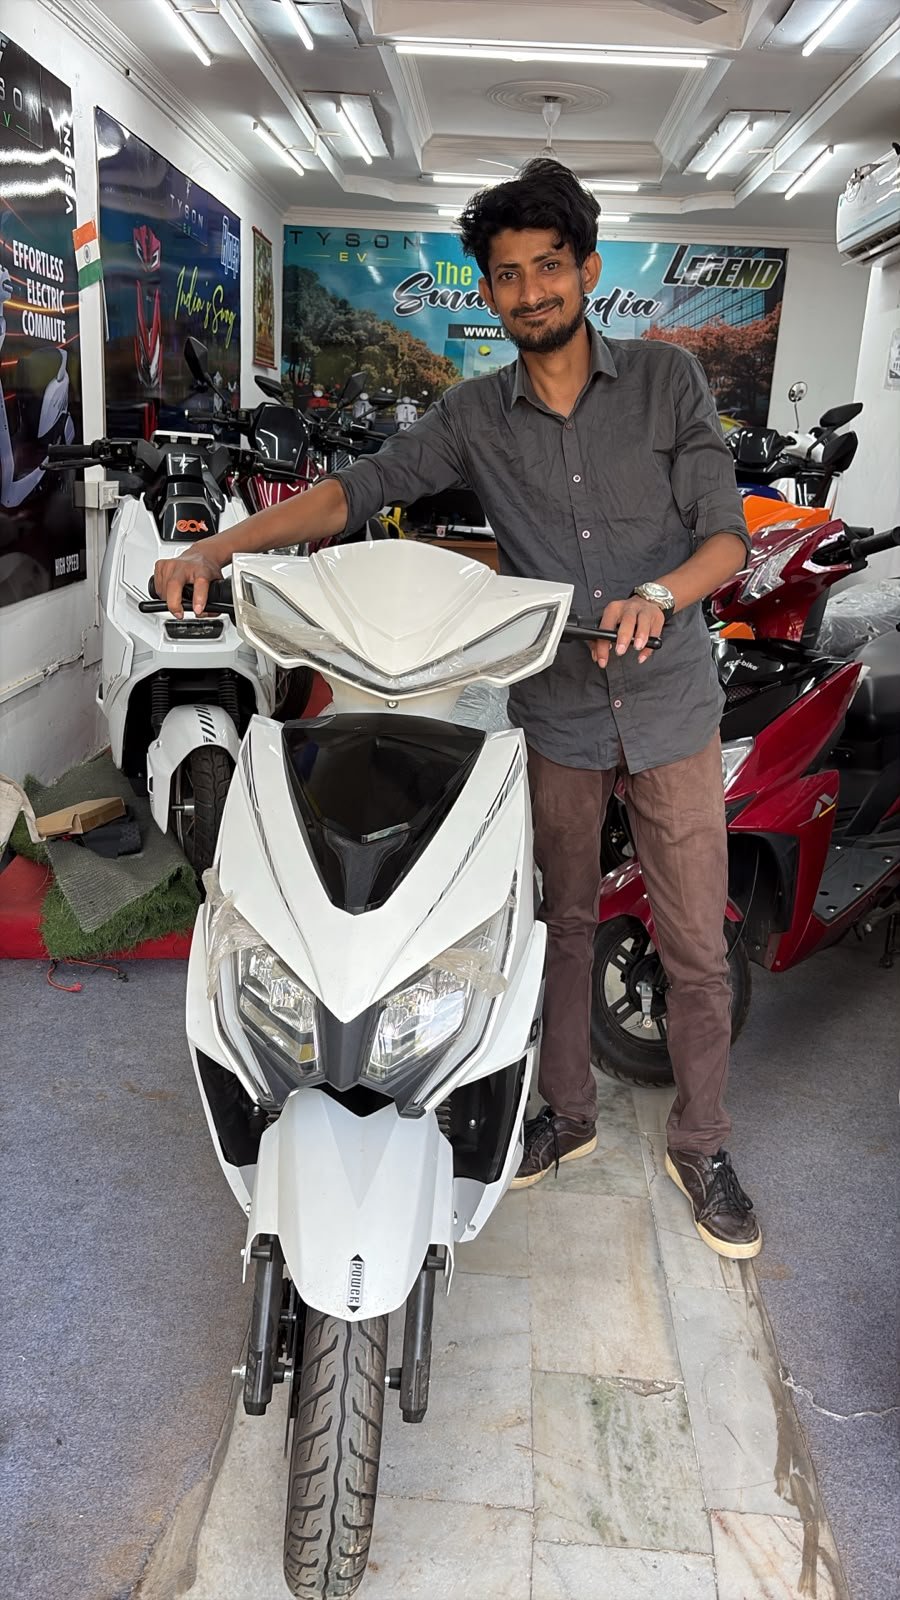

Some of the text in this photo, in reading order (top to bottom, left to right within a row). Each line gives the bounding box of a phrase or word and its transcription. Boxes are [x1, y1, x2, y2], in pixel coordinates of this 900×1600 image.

[170, 193, 204, 229] TYSON
[289, 230, 419, 249] TYSON
[339, 252, 367, 262] EV
[12, 240, 64, 283] EFFORTLESS
[435, 261, 472, 286] The
[661, 244, 784, 290] LEGEND
[26, 278, 66, 314] ELECTRIC
[393, 270, 661, 327] Sma dia
[22, 310, 66, 344] COMMUTE
[54, 553, 79, 576] HIGH SPEED
